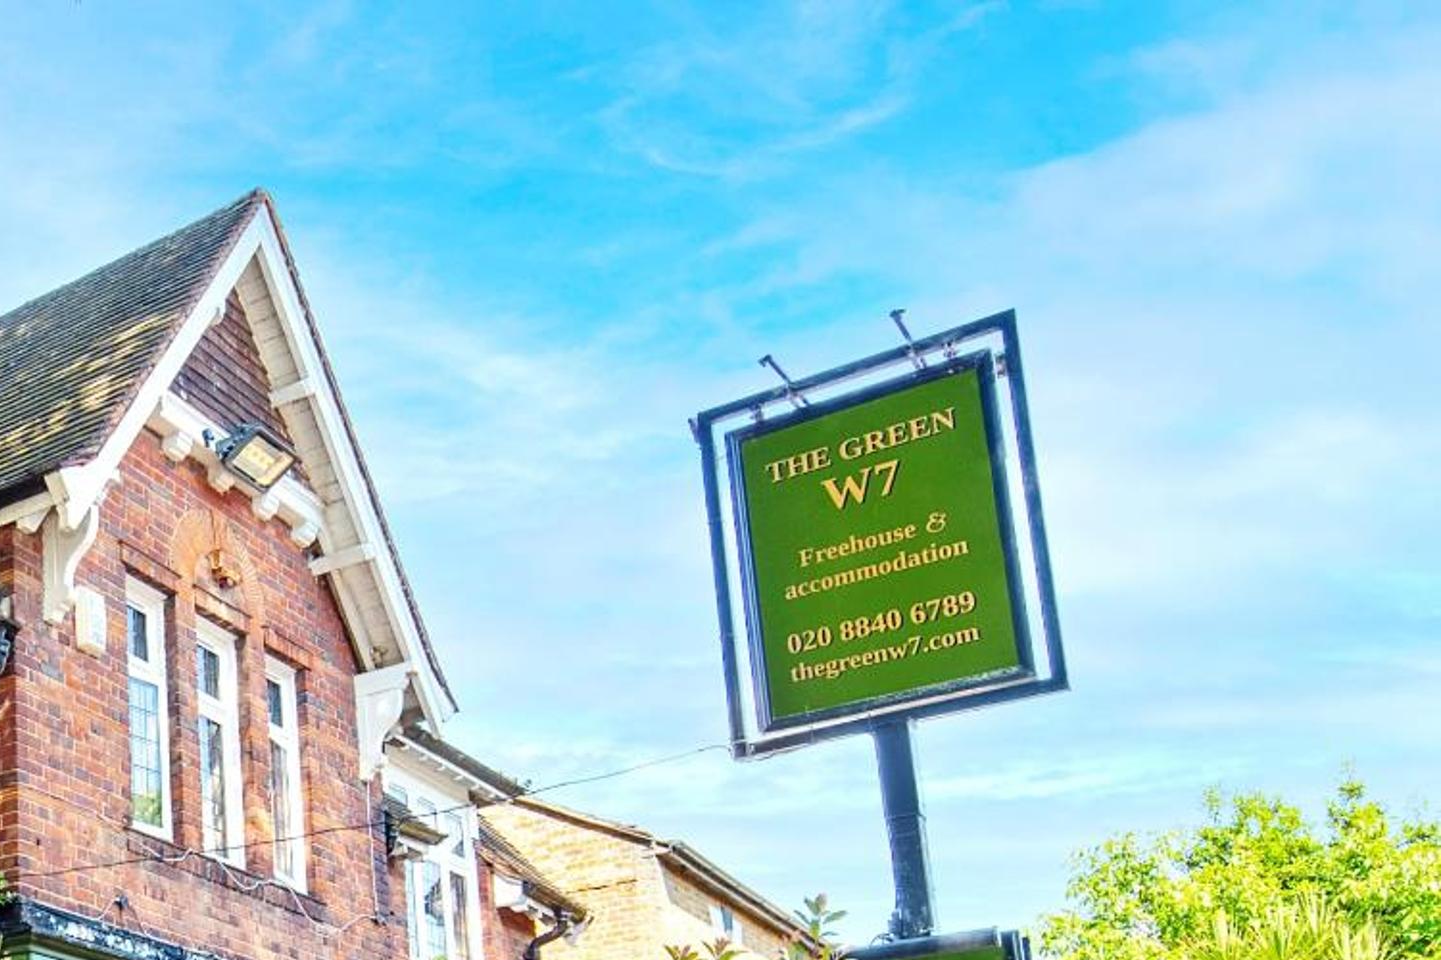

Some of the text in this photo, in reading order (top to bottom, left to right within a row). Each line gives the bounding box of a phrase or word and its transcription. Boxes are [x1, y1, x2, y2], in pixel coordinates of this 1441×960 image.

[764, 406, 957, 484] THE GREEN
[821, 459, 900, 510] W7
[783, 538, 970, 601] accommodation
[798, 511, 948, 568] Freehouse &
[786, 590, 976, 655] 020 8840 6789
[789, 624, 981, 683] thegreenw7.com
